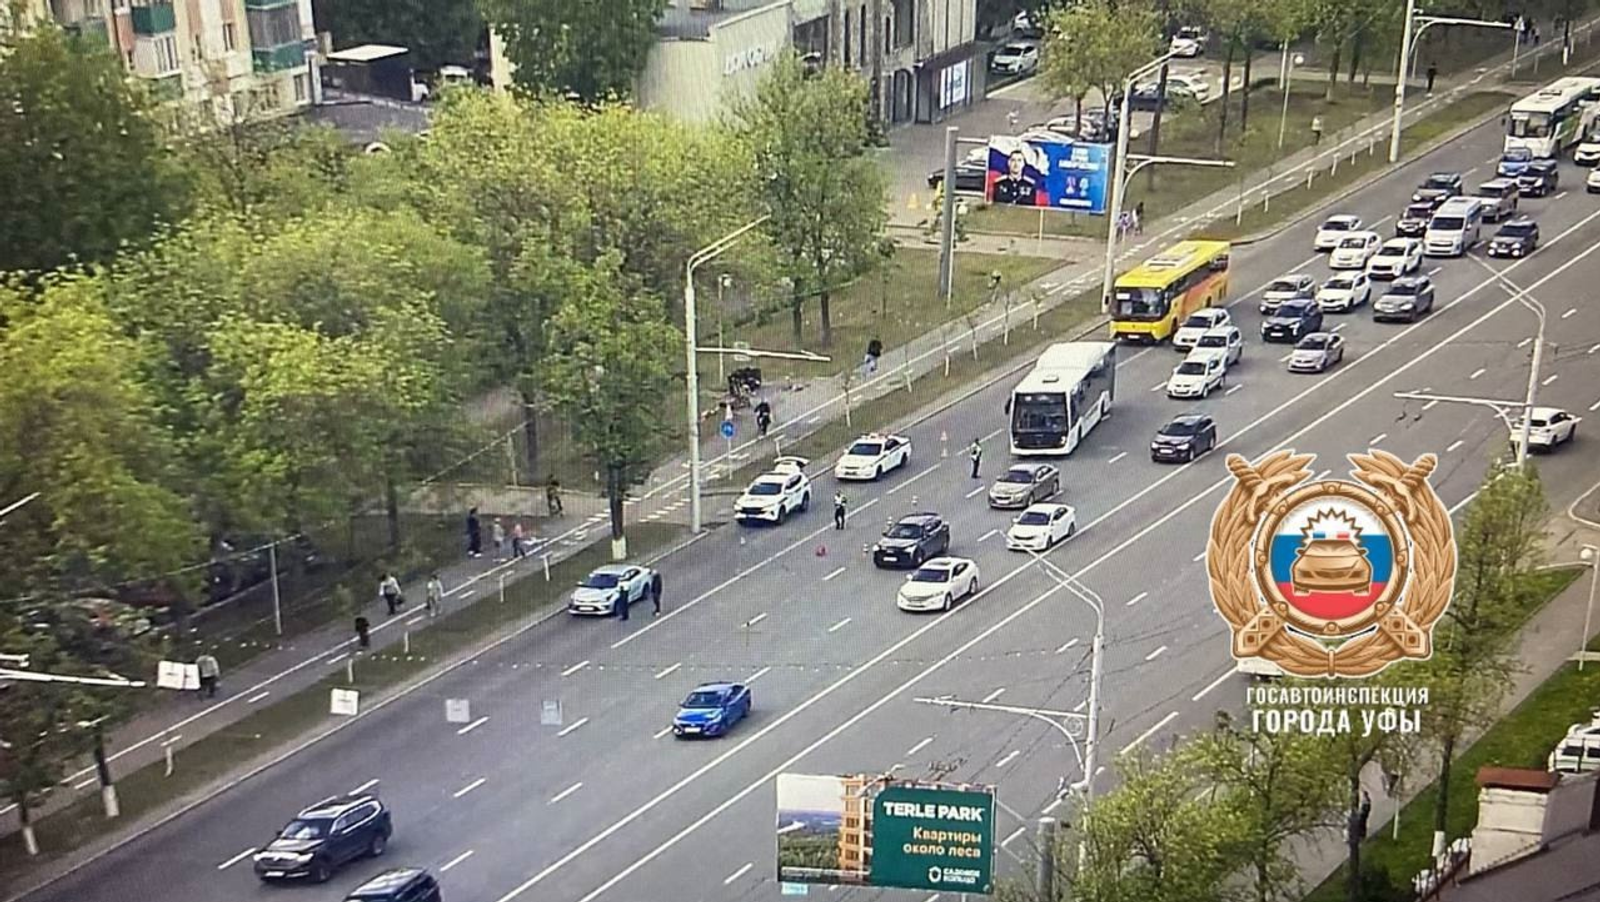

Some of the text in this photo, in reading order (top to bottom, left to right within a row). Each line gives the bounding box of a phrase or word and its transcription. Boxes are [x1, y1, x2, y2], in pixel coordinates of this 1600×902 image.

[883, 801, 982, 822] TERLE PARK
[913, 826, 982, 844] Квартиры
[902, 843, 981, 857] около леса
